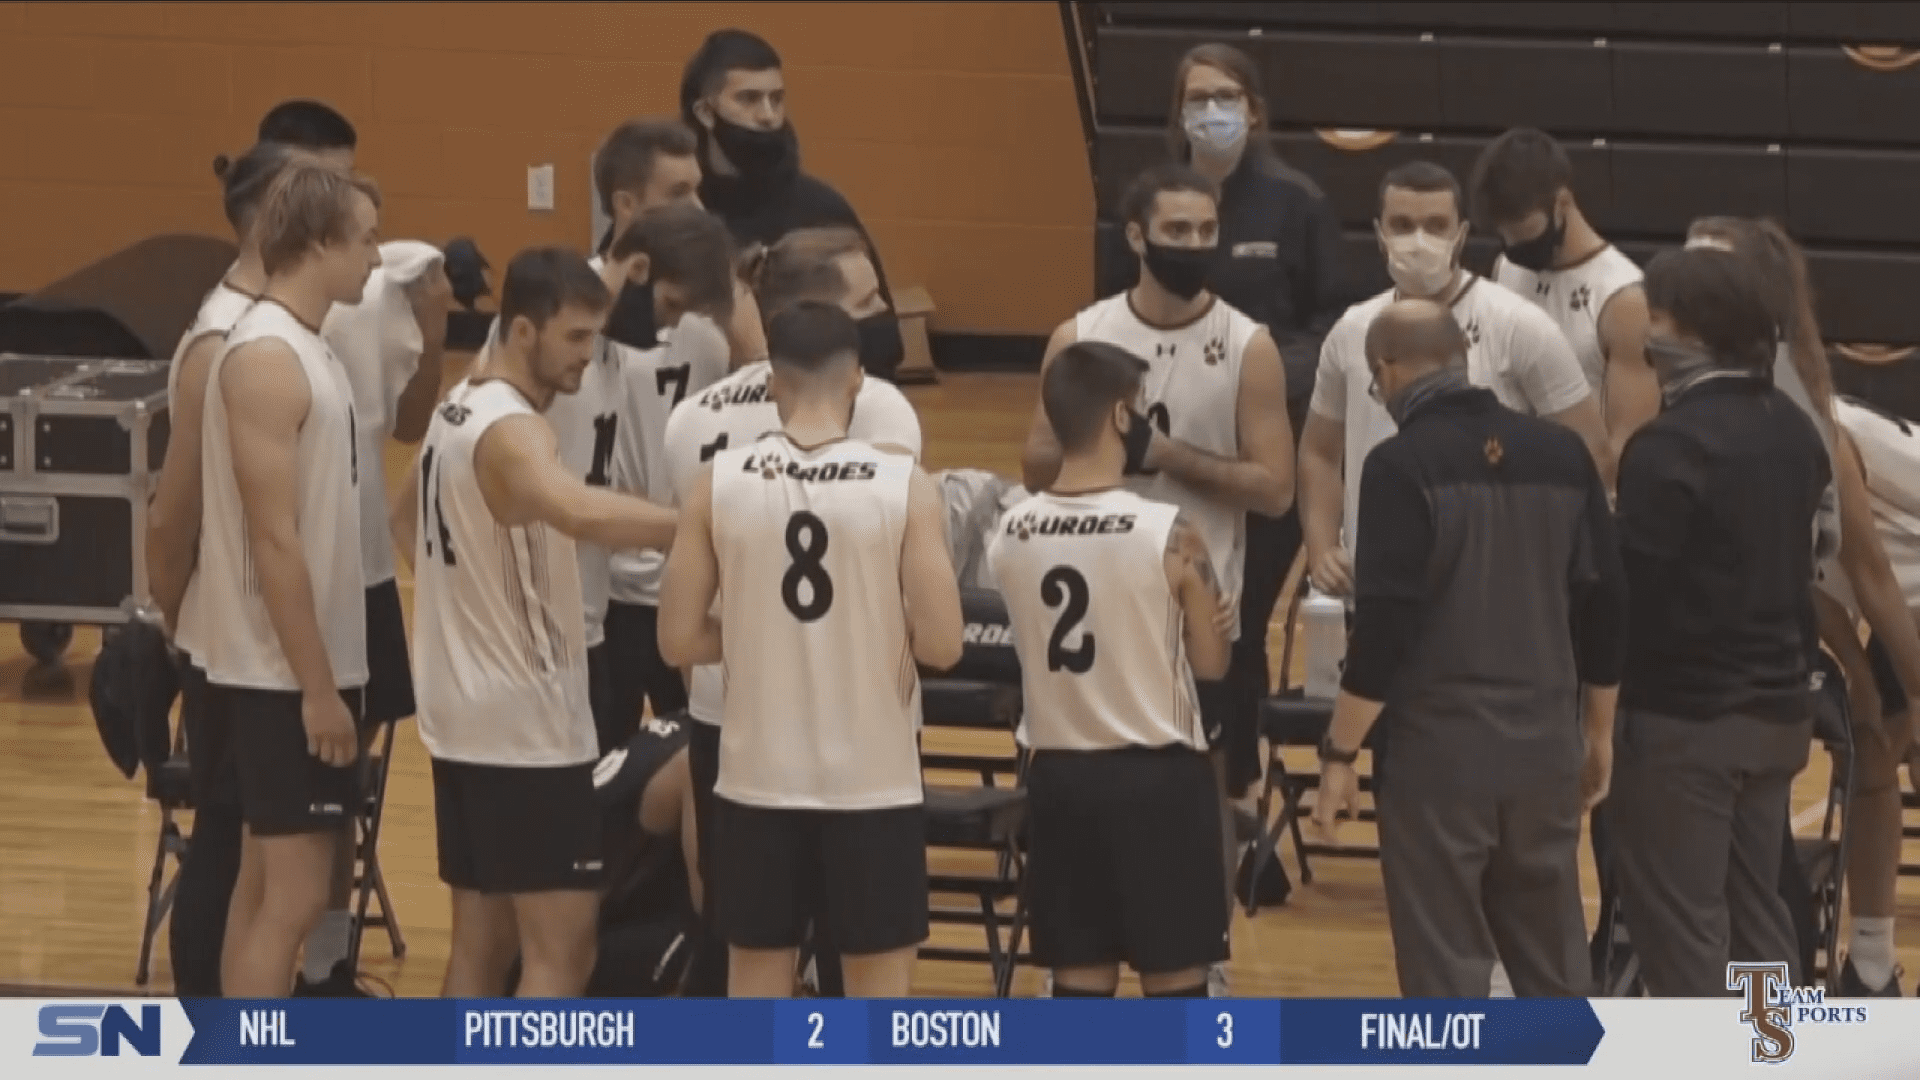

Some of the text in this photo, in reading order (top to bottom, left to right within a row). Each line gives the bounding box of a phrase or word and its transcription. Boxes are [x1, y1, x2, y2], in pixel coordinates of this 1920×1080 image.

[656, 362, 690, 411] 7
[781, 510, 833, 623] 8
[1041, 564, 1095, 674] 2
